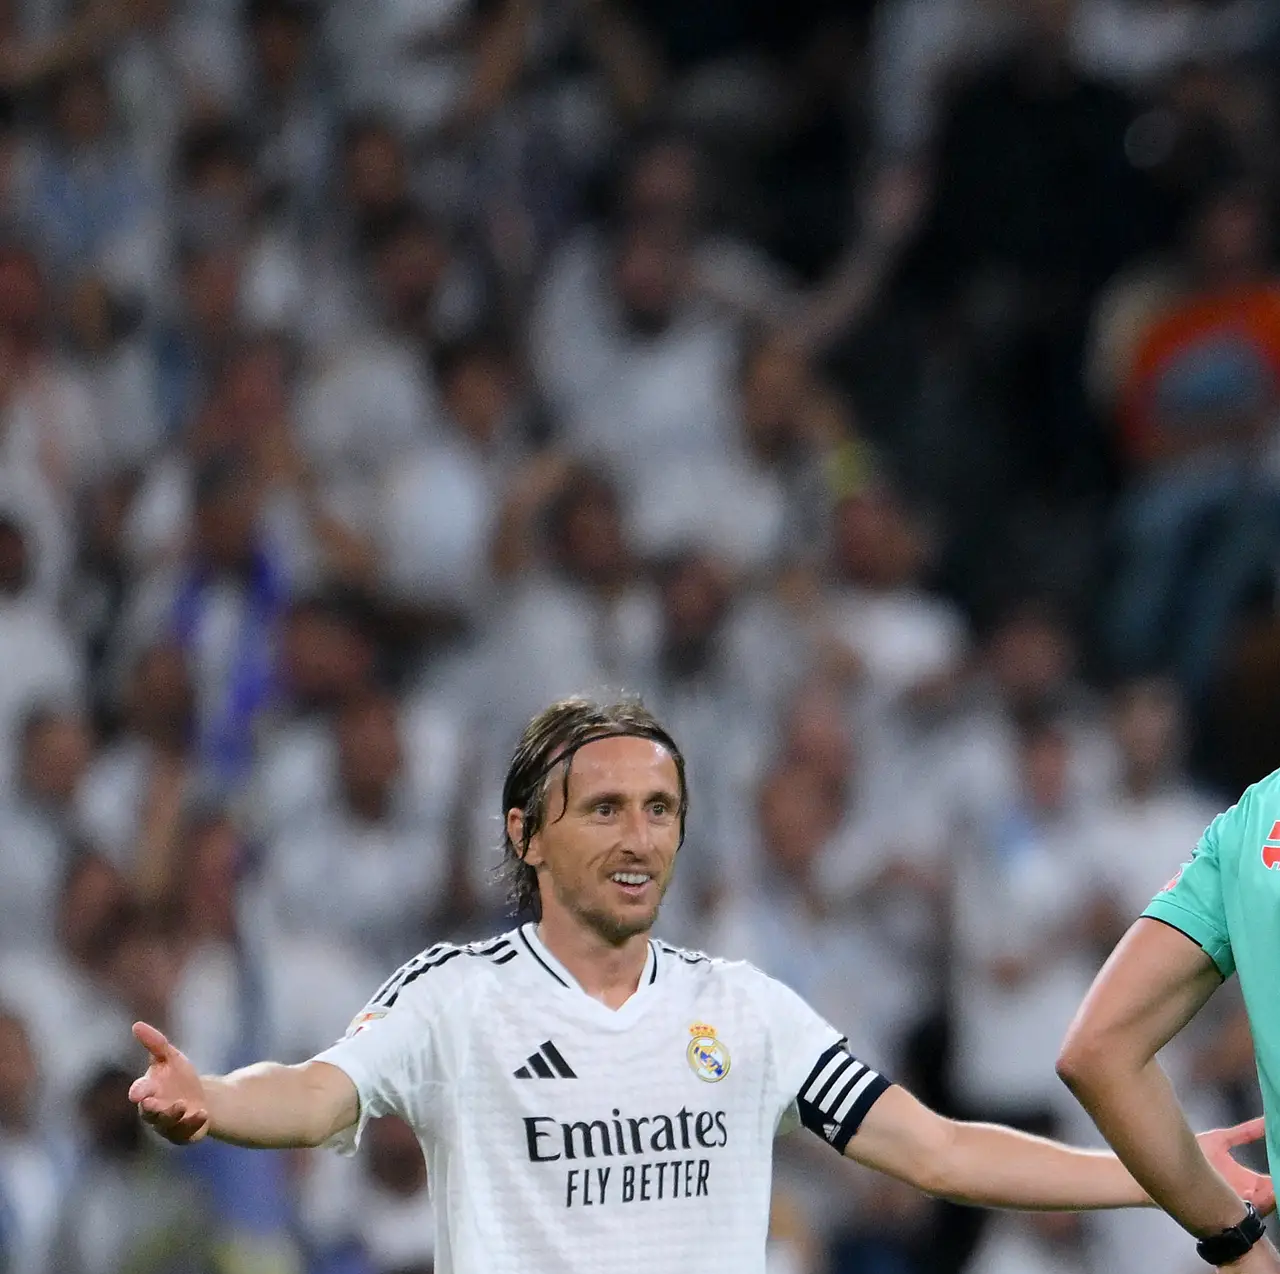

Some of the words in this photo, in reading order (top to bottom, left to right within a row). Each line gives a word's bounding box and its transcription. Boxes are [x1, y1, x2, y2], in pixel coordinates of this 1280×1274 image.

[522, 1106, 728, 1163] Emirates
[566, 1166, 611, 1208] FLY
[622, 1159, 710, 1203] BETTER
